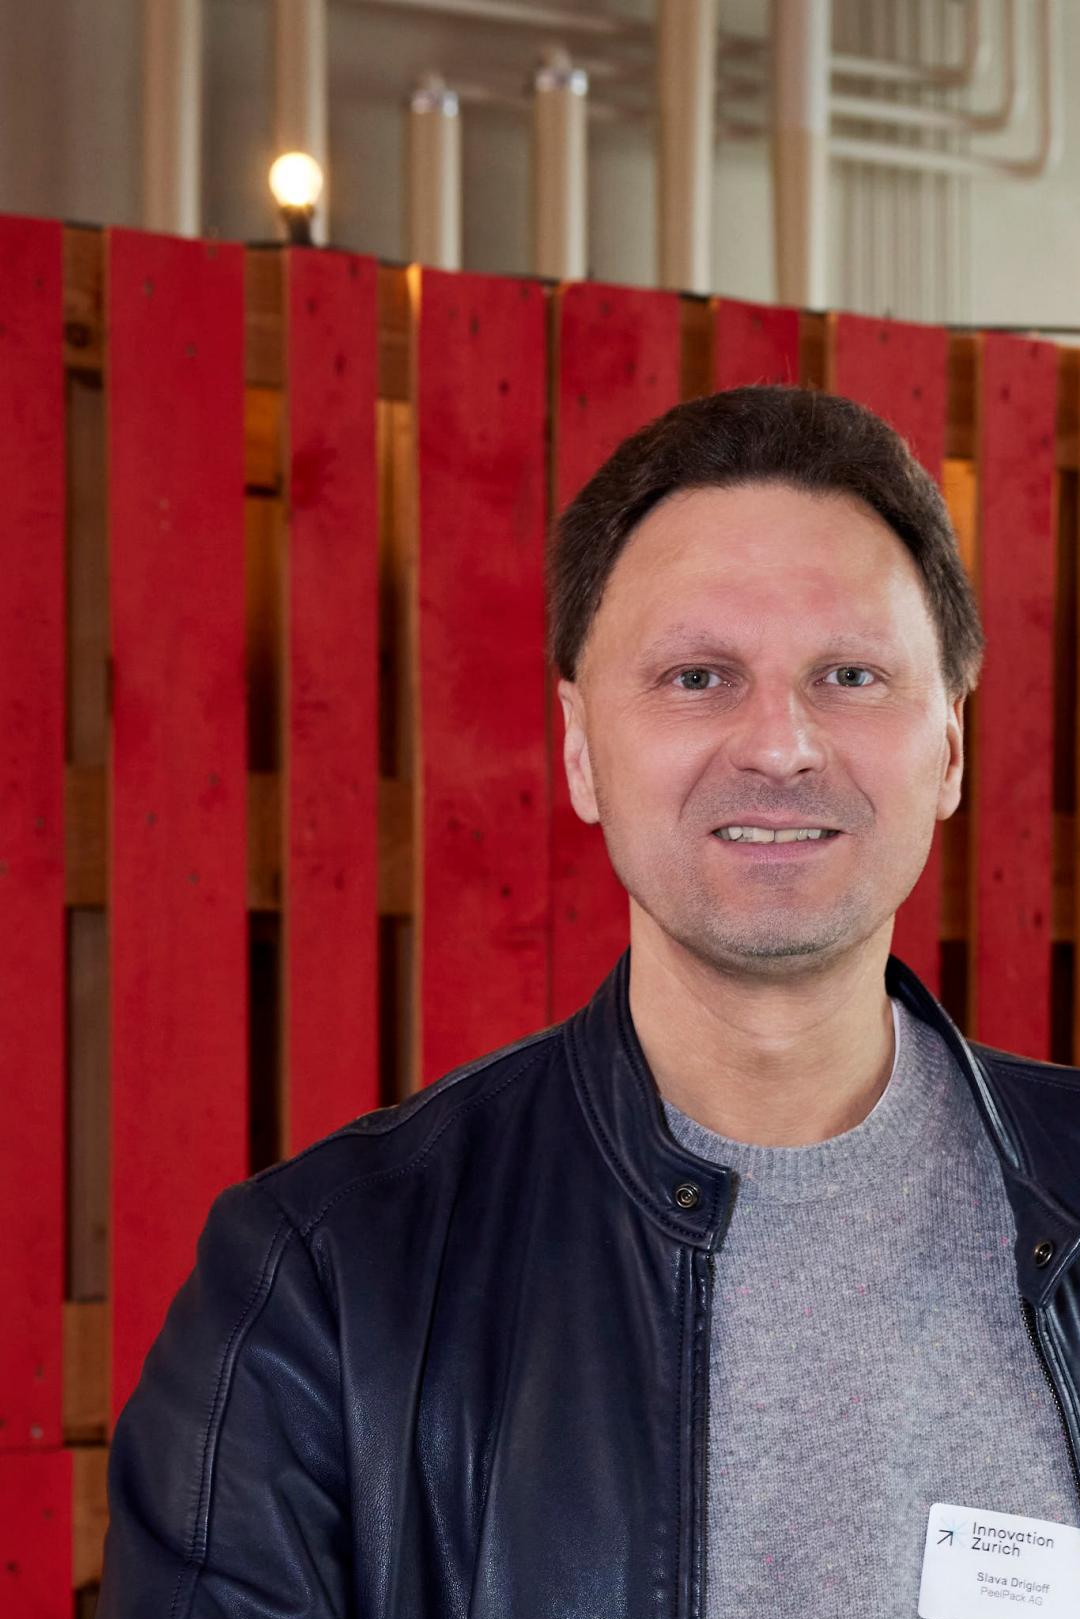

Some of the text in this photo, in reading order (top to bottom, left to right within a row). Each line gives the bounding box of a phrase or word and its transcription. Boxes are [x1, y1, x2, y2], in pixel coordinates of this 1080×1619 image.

[973, 1522, 1054, 1548] Innovation
[971, 1537, 1020, 1557] Zurich
[976, 1571, 1007, 1586] Slava
[1028, 1594, 1043, 1606] AG
